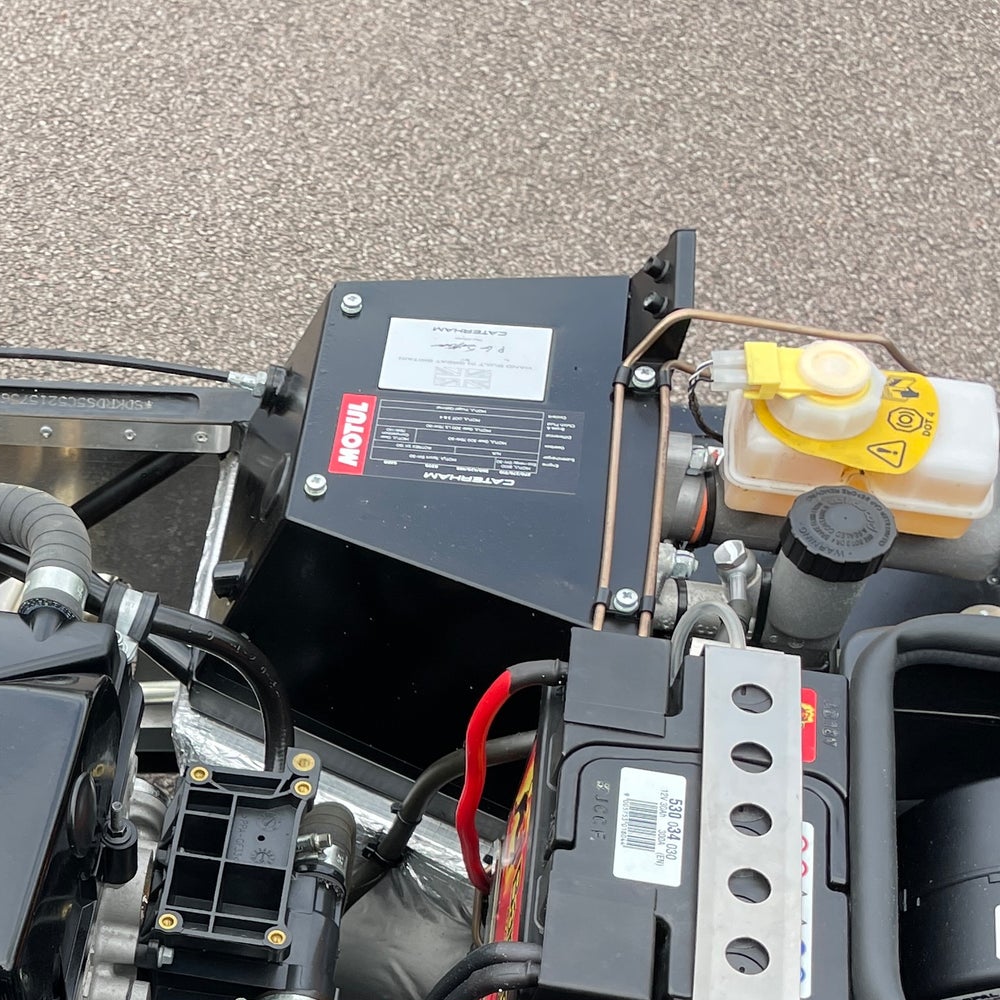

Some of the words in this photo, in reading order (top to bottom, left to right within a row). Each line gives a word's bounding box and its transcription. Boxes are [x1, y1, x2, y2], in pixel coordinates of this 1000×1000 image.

[432, 327, 507, 336] CATERHAM
[338, 401, 369, 468] MOTUL
[922, 419, 935, 437] DOT
[423, 471, 515, 486] CATERHAM
[660, 789, 669, 801] 12V
[659, 802, 668, 818] 30Ah
[668, 798, 683, 819] 530
[667, 821, 681, 841] 034
[655, 852, 665, 867] (EN)
[666, 843, 678, 861] 030
